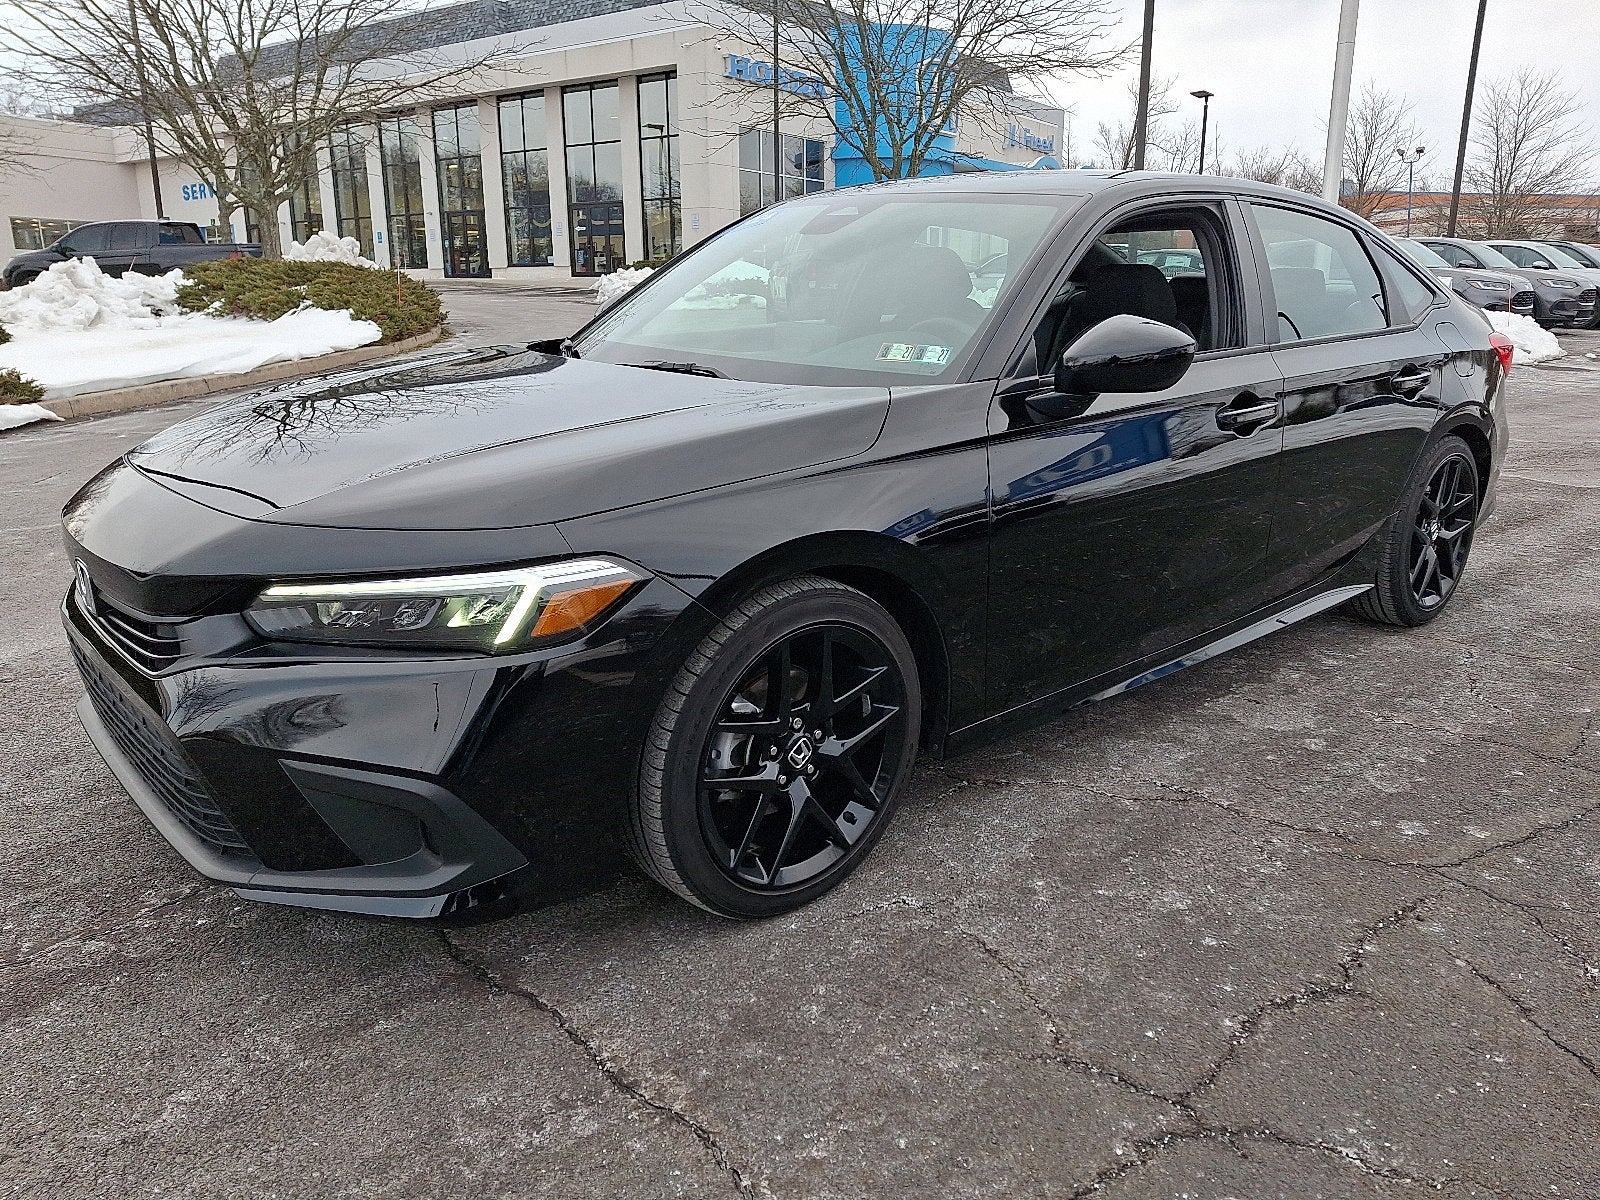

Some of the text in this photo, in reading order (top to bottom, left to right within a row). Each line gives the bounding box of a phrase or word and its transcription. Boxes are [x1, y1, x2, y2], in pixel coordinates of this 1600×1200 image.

[726, 53, 829, 99] HONDA
[1023, 127, 1055, 153] Freed
[182, 182, 217, 201] SERV
[902, 346, 914, 359] 27
[937, 348, 950, 362] 27
